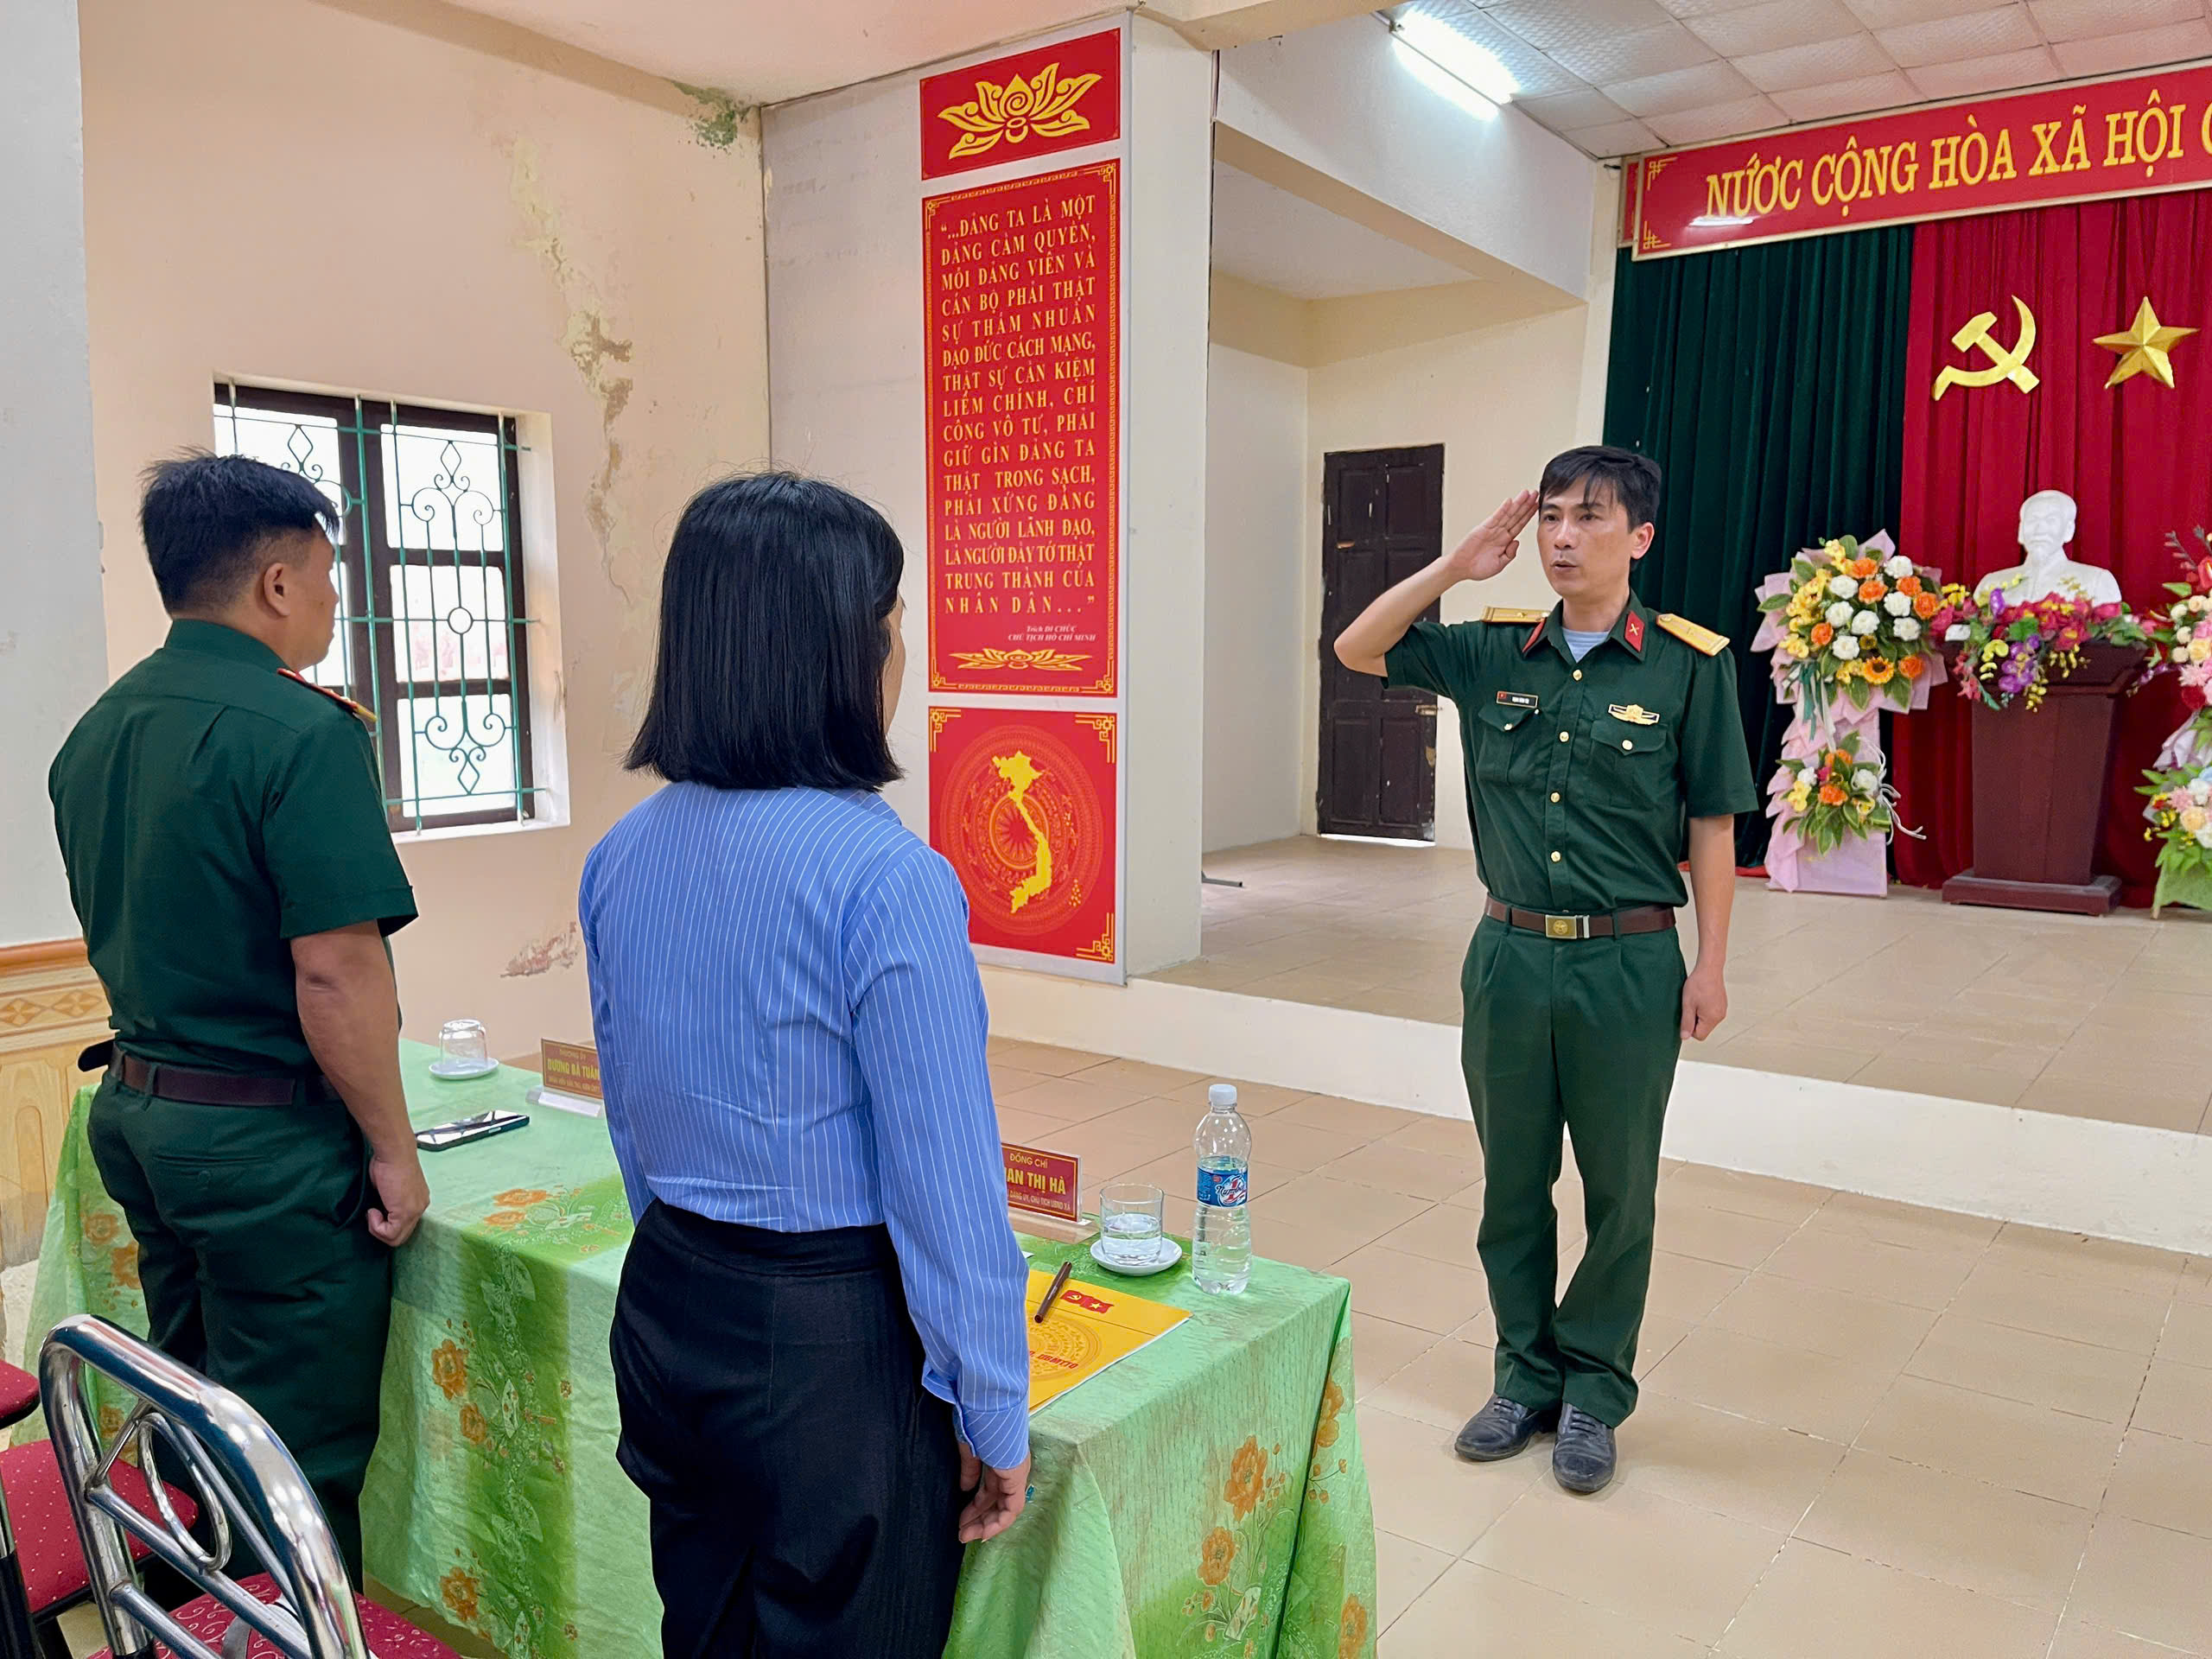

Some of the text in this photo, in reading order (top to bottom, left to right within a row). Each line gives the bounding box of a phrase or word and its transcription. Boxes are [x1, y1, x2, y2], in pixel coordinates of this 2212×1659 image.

[1705, 151, 1803, 219] NƯỚC
[1812, 136, 1919, 217] CỘNG
[1929, 114, 2018, 189] HÒA
[2029, 105, 2091, 176] XÃ
[2103, 89, 2186, 177] HỘI
[1007, 209, 1025, 228] TA
[1033, 198, 1052, 224] LÀ
[1061, 194, 1096, 220] MỘT
[1027, 251, 1065, 276] VIÊN
[1074, 245, 1096, 269] VÀ
[942, 276, 1096, 317] CÁN BỘ PHẢI THẬT
[942, 319, 963, 345] SỰ
[943, 332, 1096, 370] ĐẠO ĐỨC CÁCH MẠNG,
[988, 365, 1007, 391] SỰ
[1055, 357, 1096, 382] KIỆM
[993, 388, 1053, 413] CHÍNH,
[1064, 379, 1096, 405] CHÍ
[944, 408, 1096, 442] CÔNG VÔ TƯ, PHẢI
[944, 438, 1095, 467] GIỮ GÌN ĐẢNG TA
[944, 465, 1096, 494] THẬT TRONG SẠCH,
[944, 494, 982, 516] PHẢI
[992, 492, 1038, 513] XỨNG
[945, 517, 1095, 541] LÀ NGƯỜI LÃNH ĐẠO,
[945, 544, 961, 565] LÀ
[964, 542, 1004, 564] NGƯỜI
[1037, 540, 1057, 563] TỚ
[945, 563, 1095, 589] TRUNG THÀNH CỦA
[945, 592, 999, 613] NHÂN
[1034, 1158, 1048, 1168] CHÍ
[1027, 1172, 1046, 1193] THỊ
[1049, 1175, 1066, 1195] HÀ
